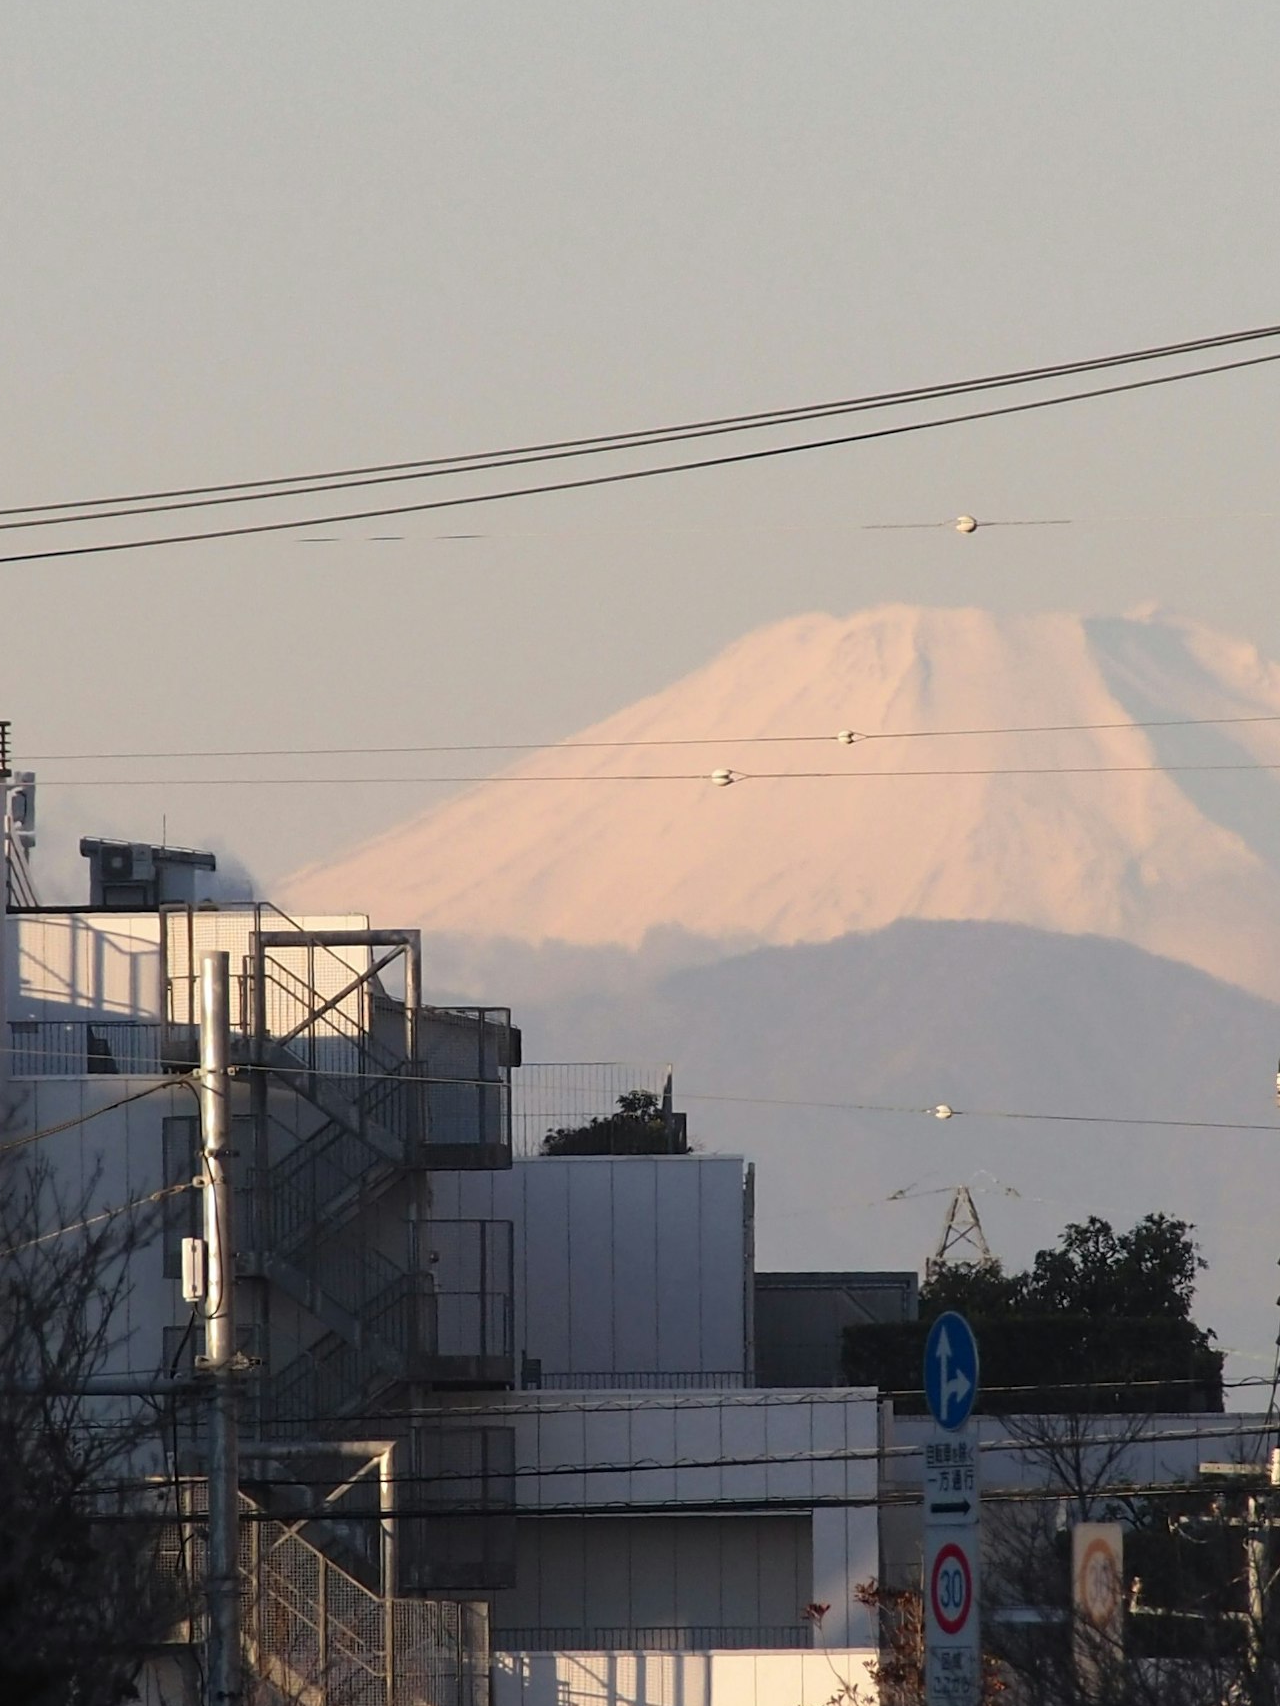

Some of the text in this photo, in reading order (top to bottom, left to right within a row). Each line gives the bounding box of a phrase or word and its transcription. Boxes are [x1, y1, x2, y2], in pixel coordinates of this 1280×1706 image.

[927, 1442, 975, 1464] 自転車を除く
[928, 1469, 974, 1491] 一方通行
[939, 1569, 963, 1609] 30
